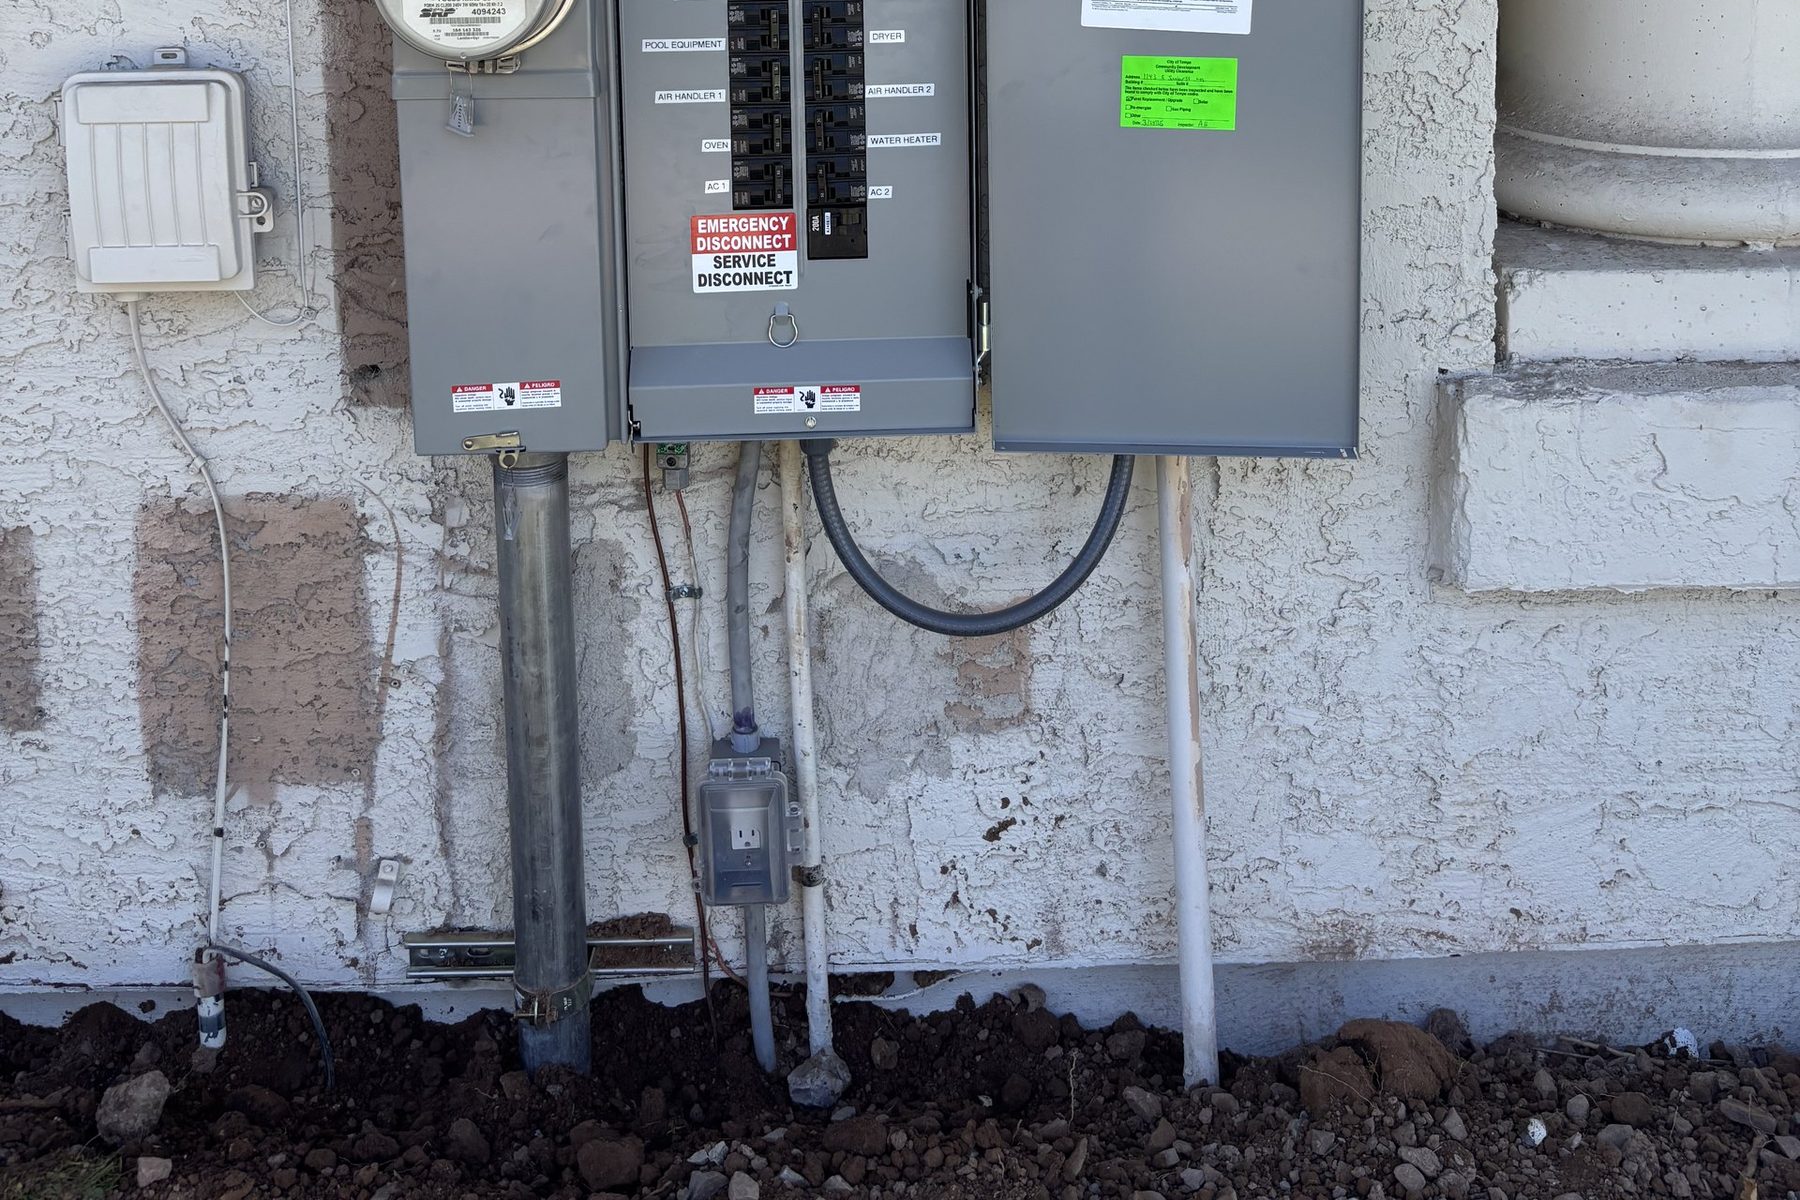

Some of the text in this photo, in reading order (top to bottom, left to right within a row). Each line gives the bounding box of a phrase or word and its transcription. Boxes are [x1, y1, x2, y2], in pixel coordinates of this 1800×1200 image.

[419, 7, 507, 18] SRP 4094243
[872, 32, 902, 41] DRYER
[645, 40, 723, 49] POOL EQUIPMENT
[868, 85, 932, 95] AIR HANDLER 2
[658, 91, 723, 101] AIR HANDLER 1
[870, 135, 938, 145] WATER HEATER
[704, 141, 729, 150] OVEN
[707, 182, 726, 191] AC 1
[870, 188, 890, 196] AC 2
[697, 216, 790, 234] EMERGENCY
[696, 233, 792, 251] DISCONNECT
[713, 253, 776, 269] SERVICE
[697, 270, 793, 287] DISCONNECT
